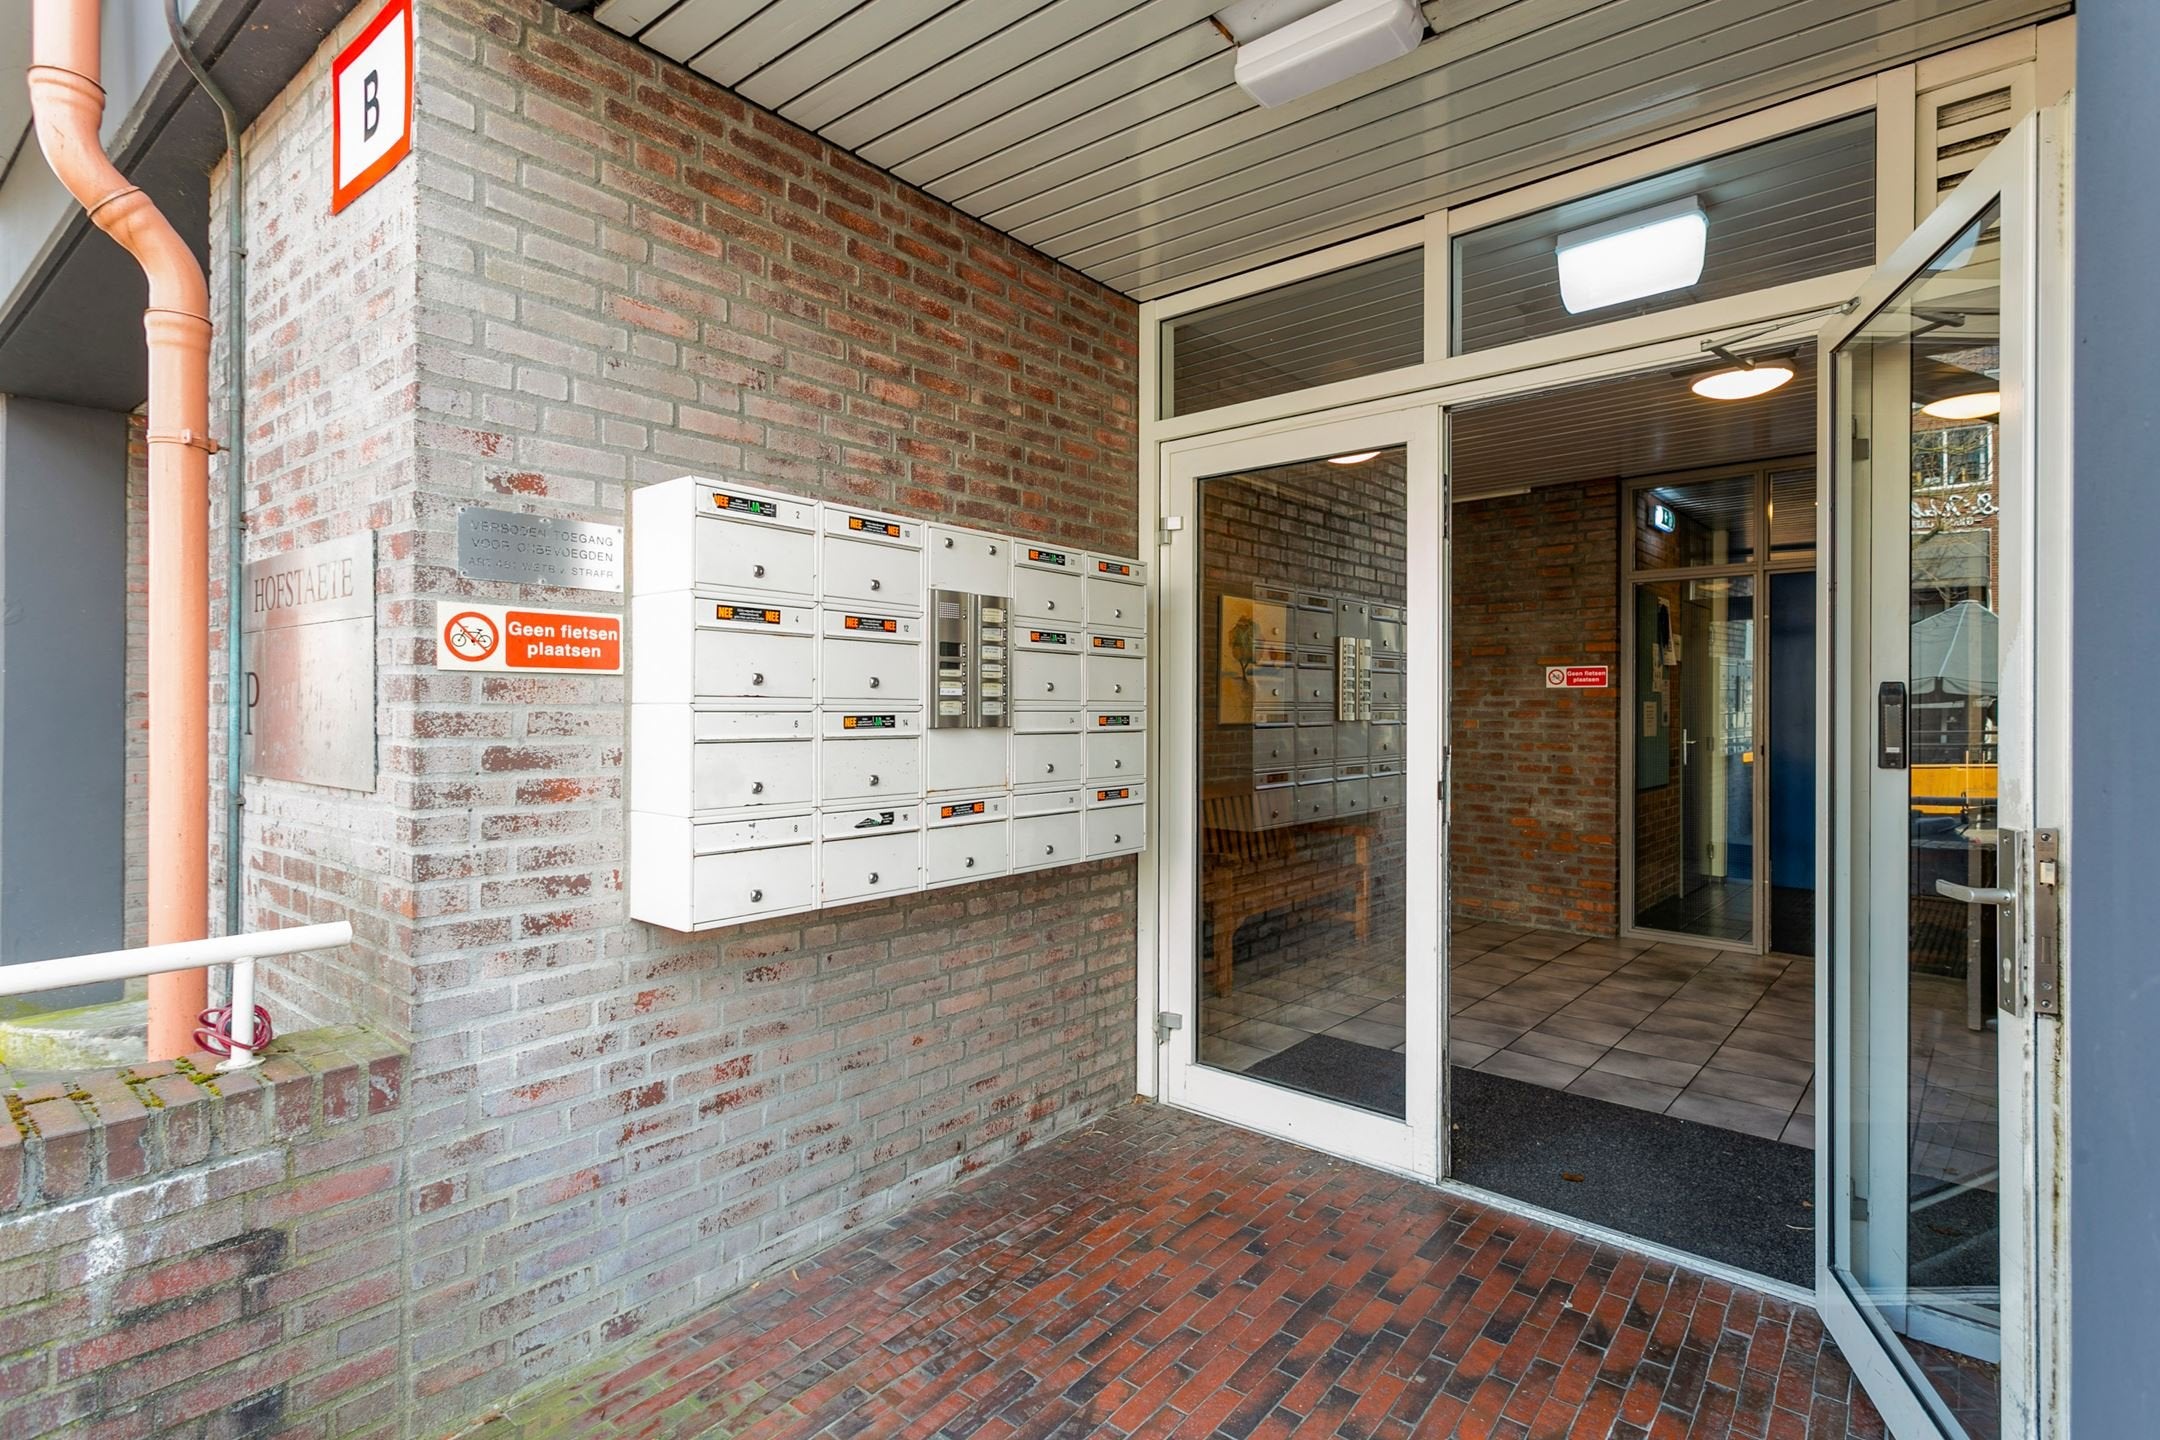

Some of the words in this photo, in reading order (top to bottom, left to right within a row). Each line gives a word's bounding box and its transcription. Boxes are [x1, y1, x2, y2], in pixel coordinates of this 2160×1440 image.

[363, 69, 380, 143] B
[750, 501, 760, 513] JA
[795, 510, 801, 520] 2
[849, 517, 863, 530] NEE
[470, 519, 547, 538] VERBODEN
[552, 529, 615, 547] TOEGANG
[887, 524, 900, 537] NEE
[471, 537, 511, 551] VOOR
[253, 557, 354, 613] HOFSTAETE
[717, 606, 734, 619] NEE
[765, 610, 780, 623] NEE
[846, 616, 859, 628] NEE
[903, 624, 910, 633] 12
[507, 620, 556, 638] Geen
[560, 624, 618, 641] fietsen
[527, 641, 602, 659] plaatsen
[844, 716, 857, 728] NEE
